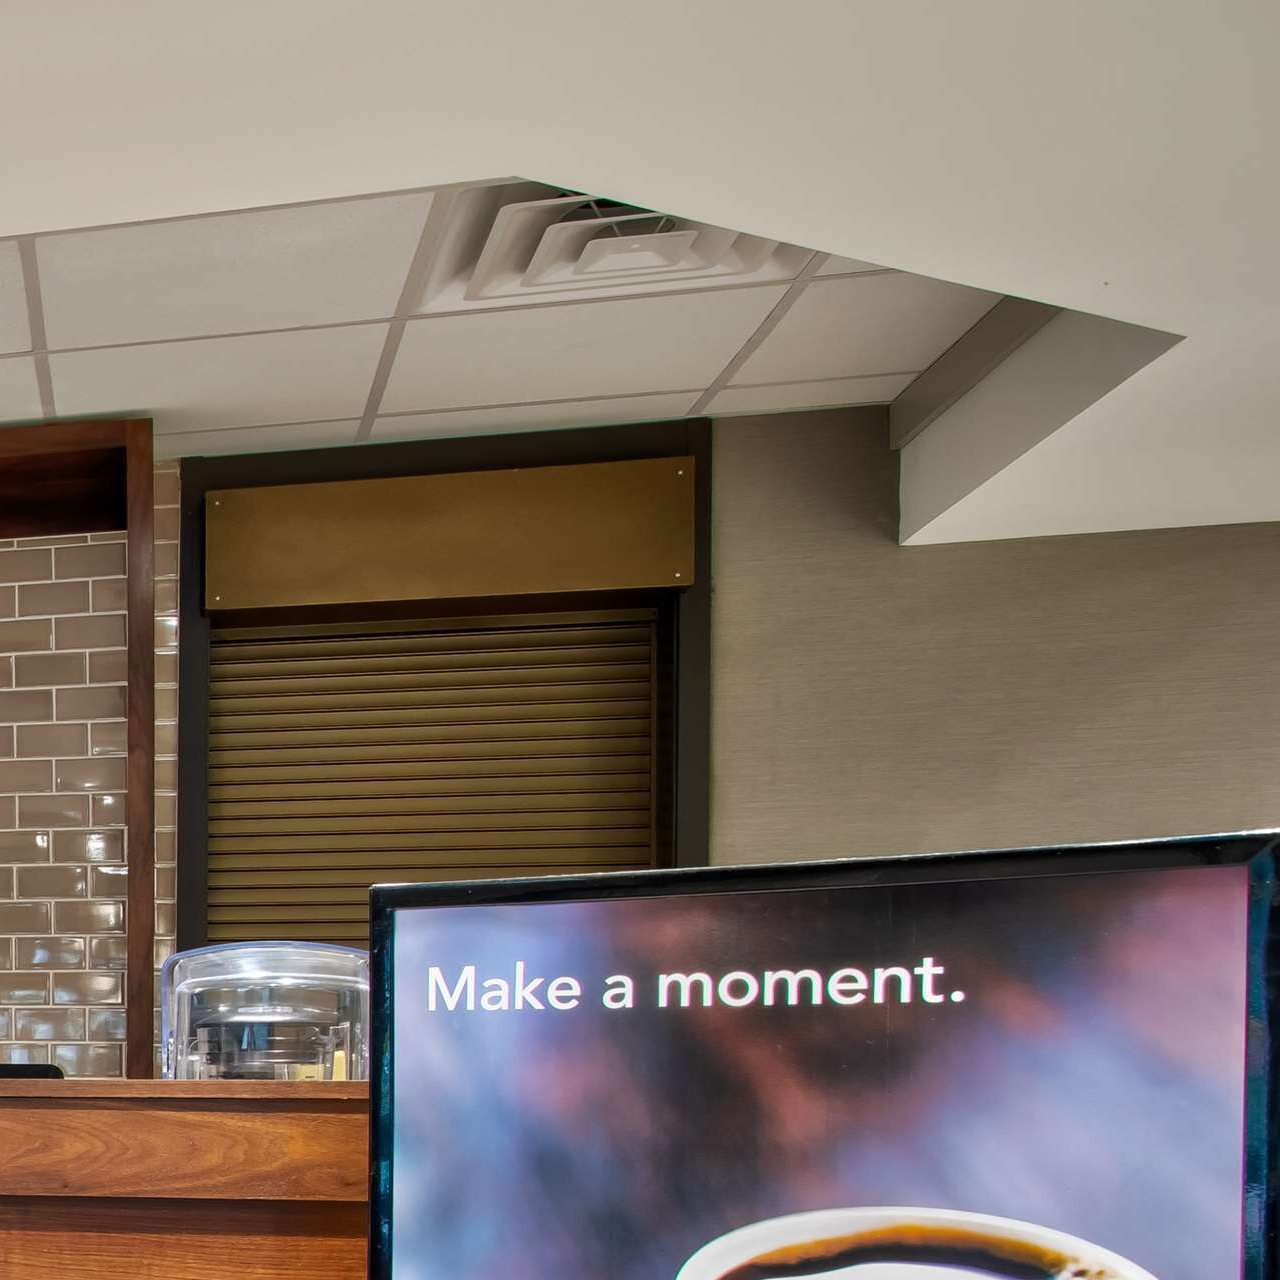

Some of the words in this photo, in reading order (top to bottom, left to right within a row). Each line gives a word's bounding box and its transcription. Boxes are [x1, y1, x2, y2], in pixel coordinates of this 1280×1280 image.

[426, 961, 582, 1012] Make
[601, 972, 634, 1010] a
[657, 956, 966, 1008] moment.
